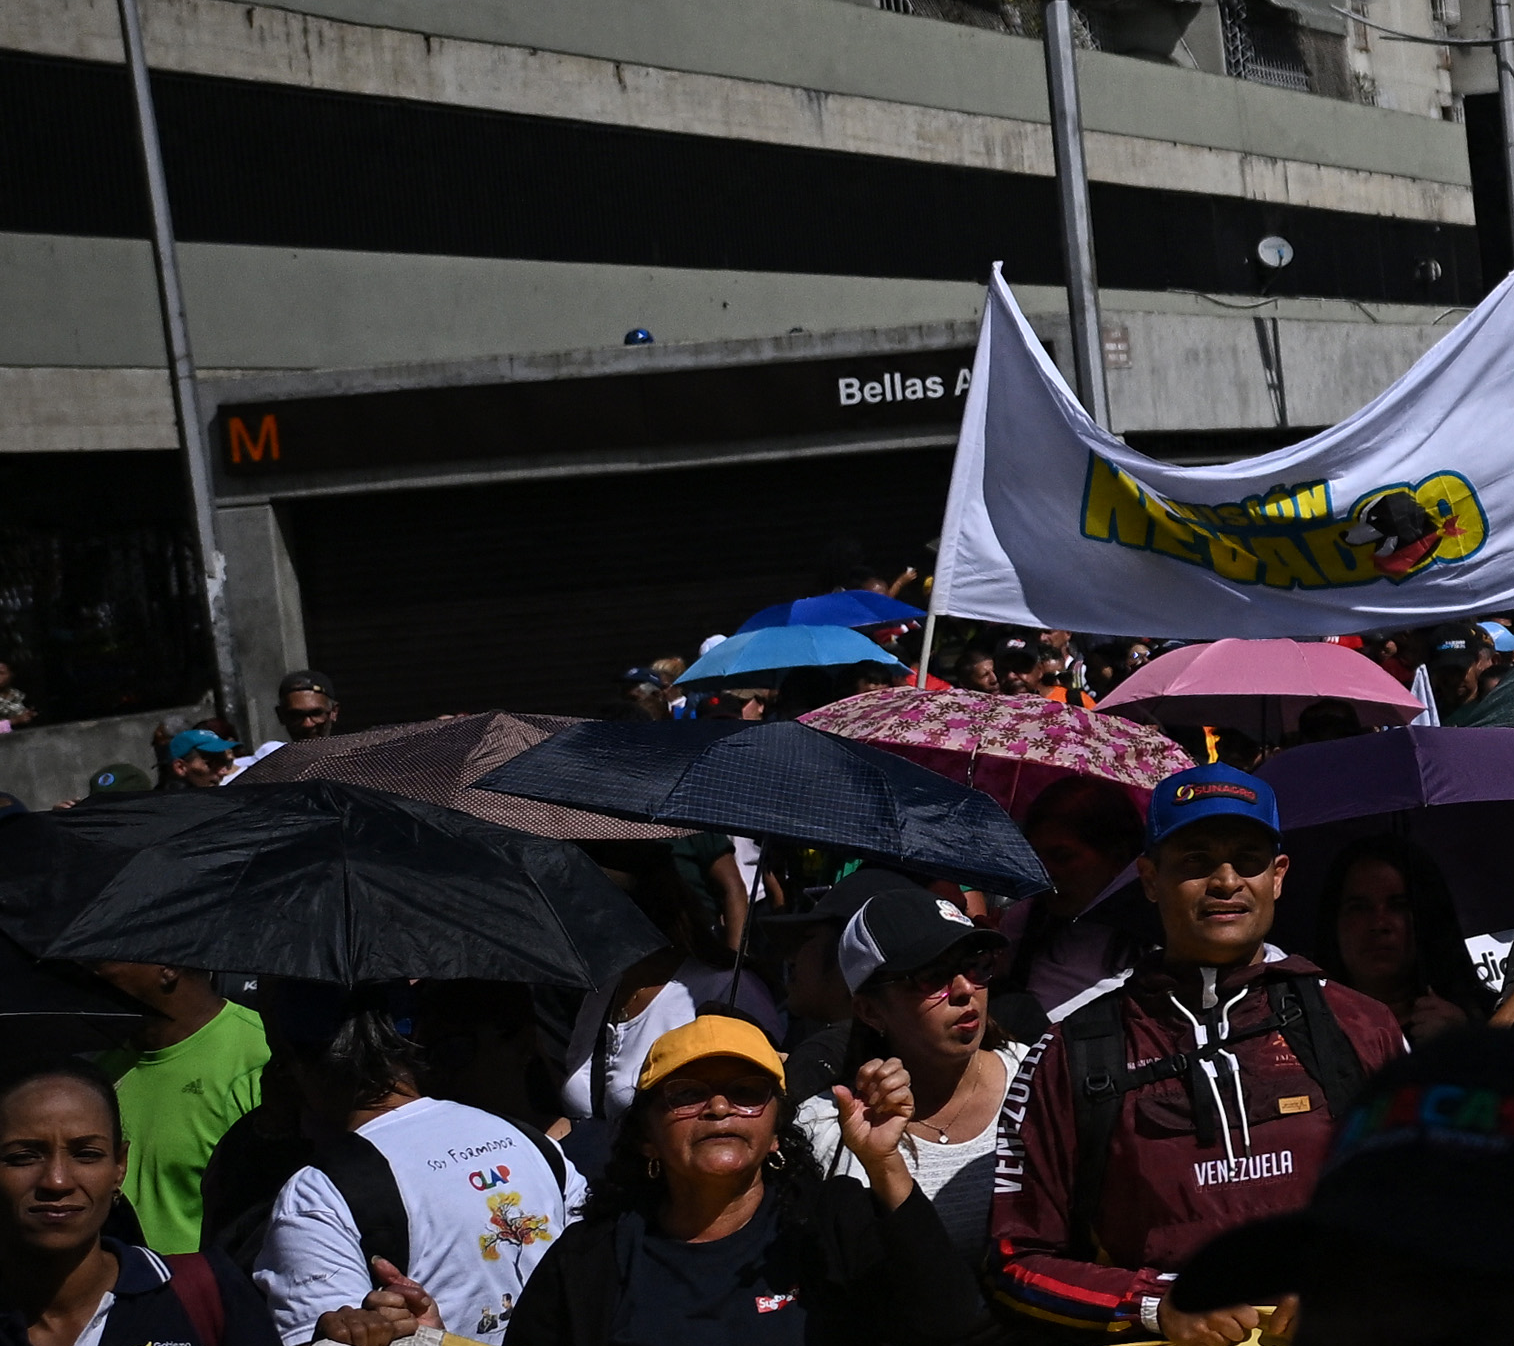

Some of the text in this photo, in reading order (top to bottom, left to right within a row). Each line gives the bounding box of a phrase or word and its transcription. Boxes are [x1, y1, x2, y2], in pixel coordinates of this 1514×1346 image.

[837, 370, 946, 408] Bellas
[230, 415, 281, 464] M
[993, 1032, 1054, 1195] VENEZUELA
[468, 1164, 511, 1192] CLAP
[1193, 1149, 1294, 1187] VENEZUELA
